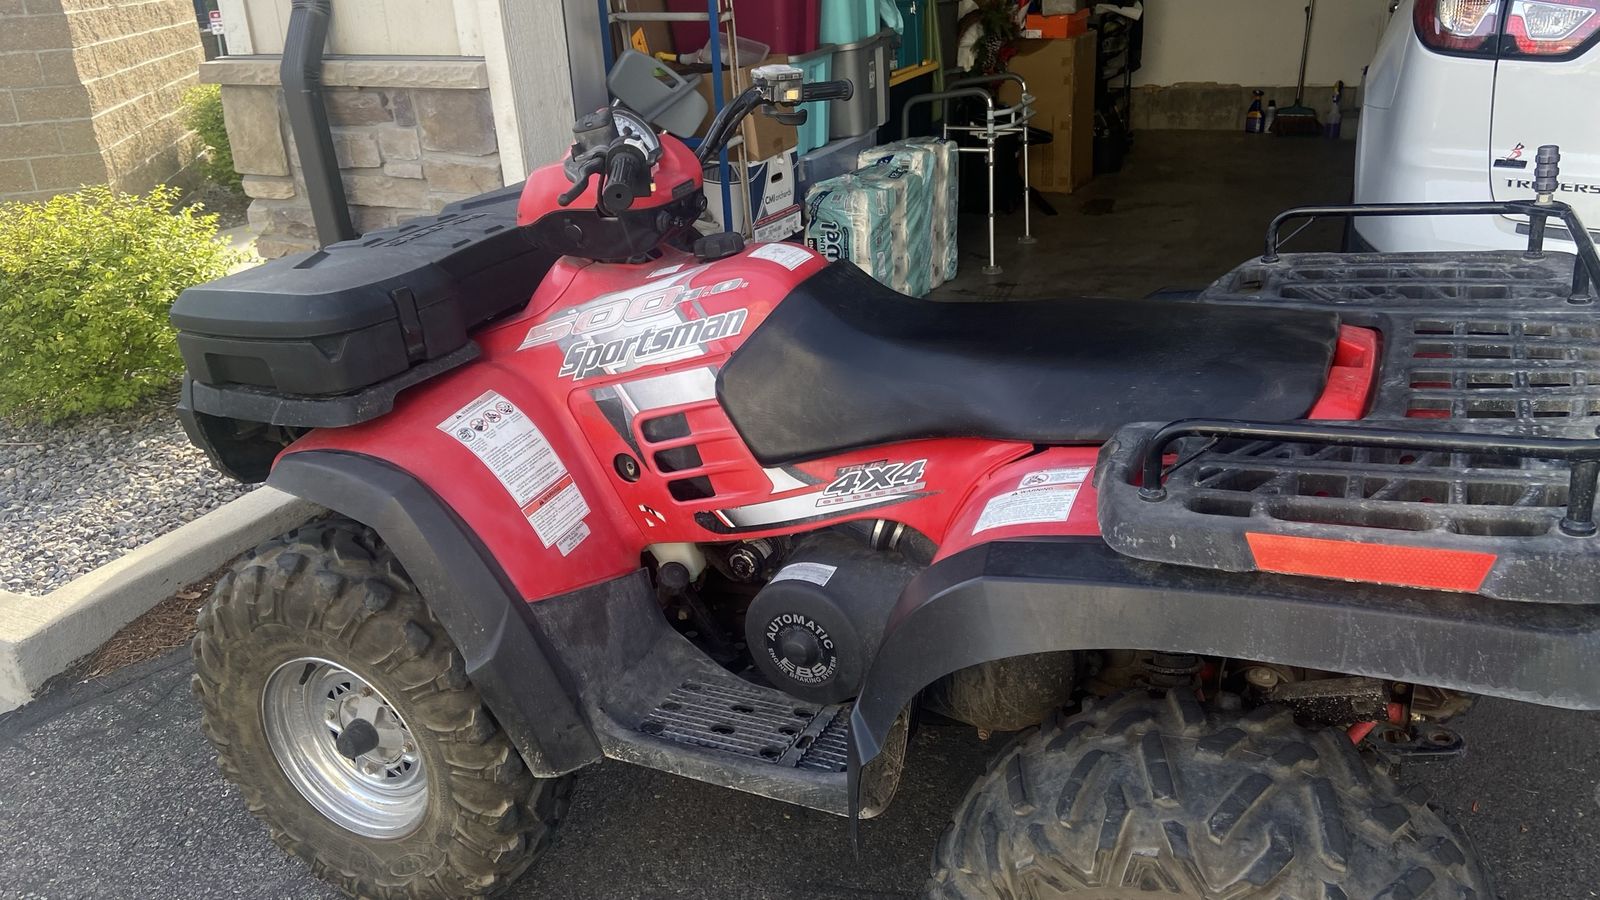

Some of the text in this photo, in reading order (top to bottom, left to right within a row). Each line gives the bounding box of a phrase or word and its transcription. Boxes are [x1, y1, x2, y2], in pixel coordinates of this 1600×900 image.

[765, 193, 775, 205] CMI
[516, 285, 684, 351] 500
[558, 308, 749, 381] Sportsman
[766, 613, 834, 650] AUTOMATIC
[768, 647, 837, 684] ENGINE BRAKING SYSTEM
[780, 656, 827, 678] EBS
